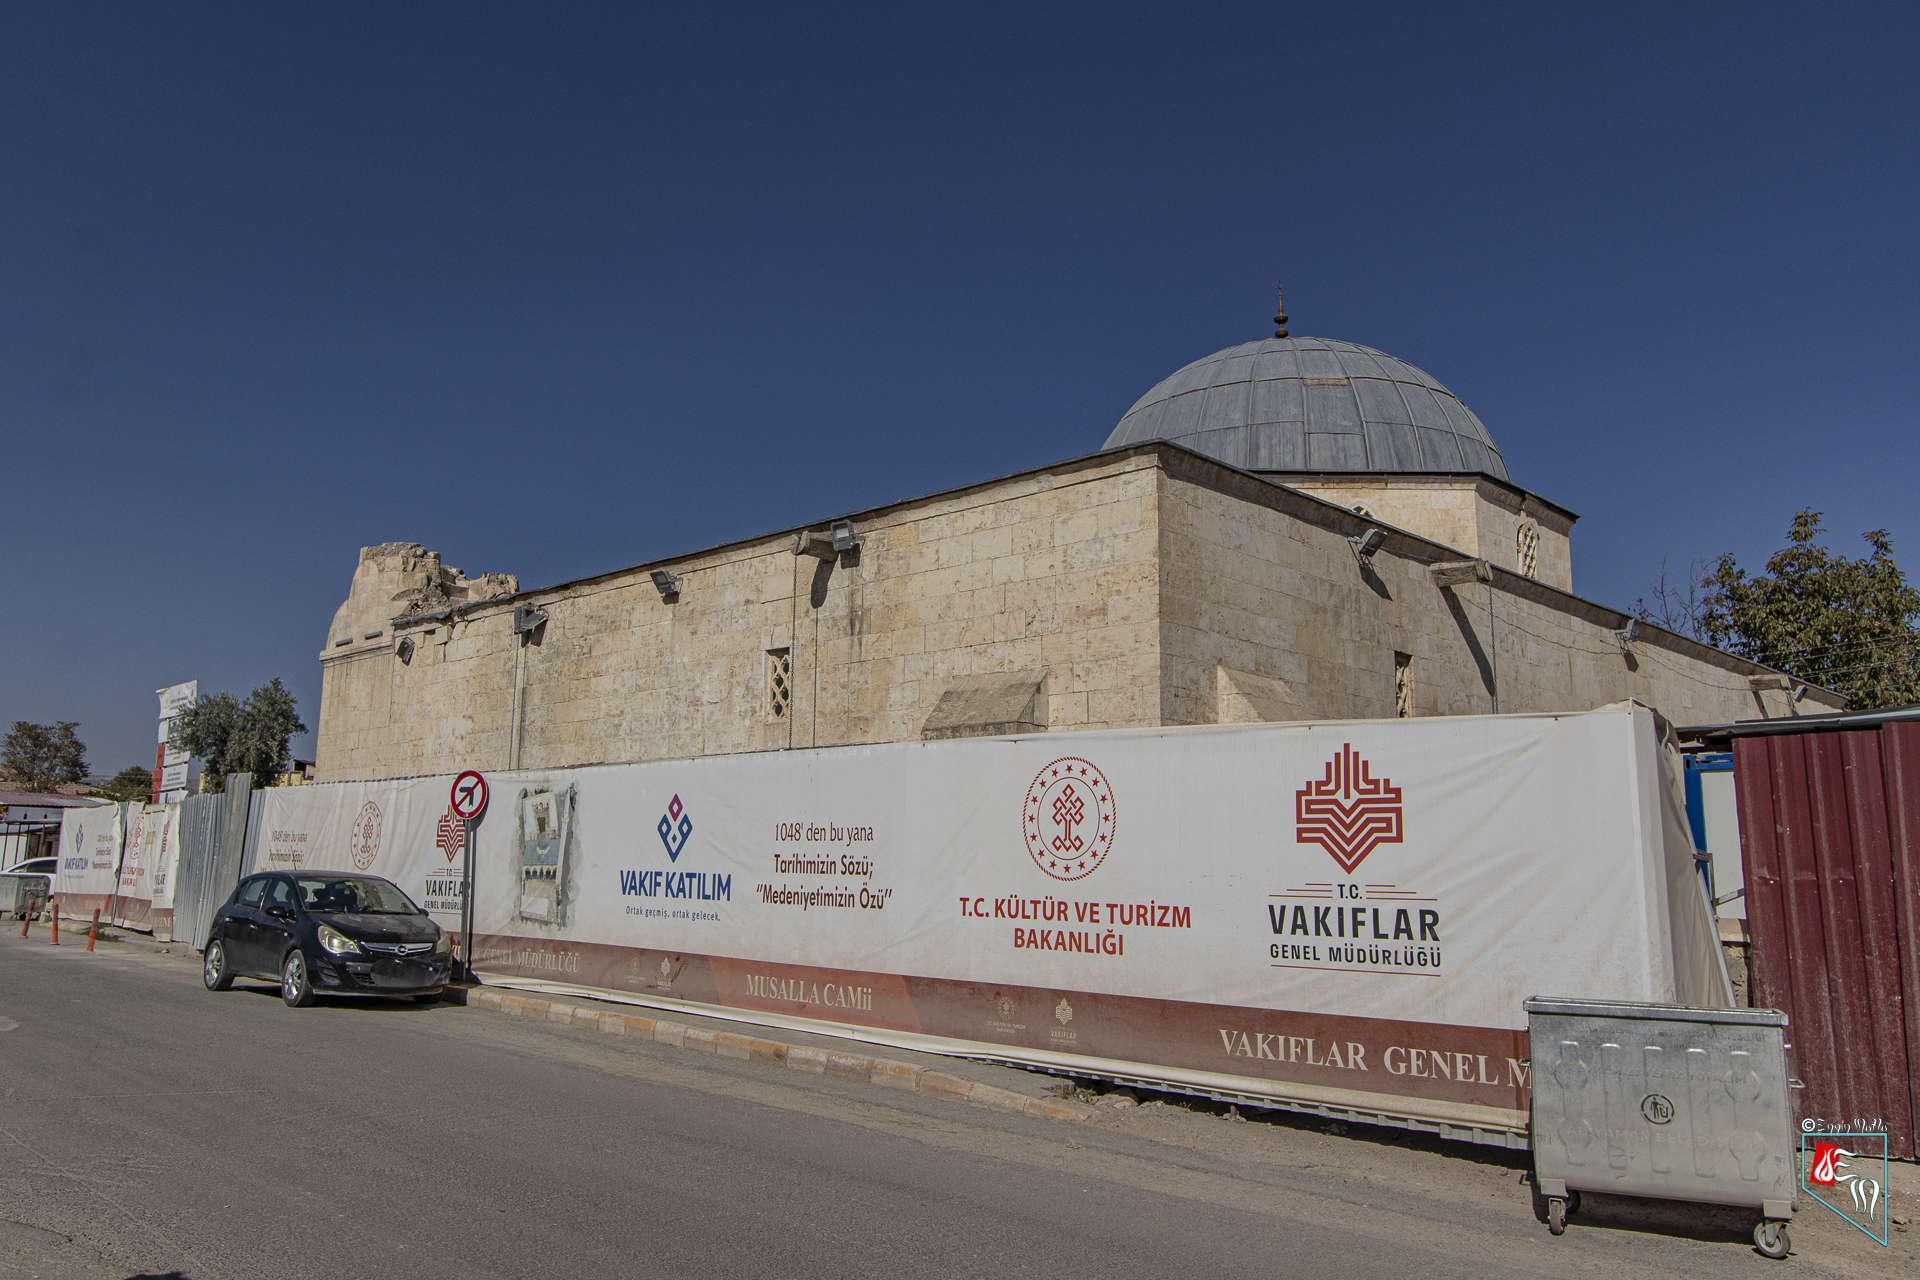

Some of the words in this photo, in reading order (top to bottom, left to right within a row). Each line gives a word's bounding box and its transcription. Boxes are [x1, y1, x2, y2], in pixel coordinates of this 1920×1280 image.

[774, 821, 804, 842] 1048'
[806, 822, 826, 843] den
[830, 821, 843, 843] bu
[847, 825, 874, 847] yana
[774, 852, 837, 876] Tarihimizin
[840, 855, 874, 880] Sözü;
[620, 869, 662, 898] VAKIF
[665, 871, 732, 902] KATILIM
[1337, 883, 1363, 900] T.C.
[424, 900, 439, 909] GENEL
[625, 904, 644, 917] Ortak
[645, 907, 670, 920] geçmiş,
[672, 909, 690, 922] ortak
[691, 910, 721, 923] gelecek.
[959, 896, 990, 919] T.C.
[994, 893, 1069, 923] KÜLTÜR
[1074, 900, 1100, 924] VE
[1106, 899, 1192, 929] TURİZM
[1267, 904, 1441, 942] VAKIFLAR
[1013, 927, 1124, 956] BAKANLIĞI
[1269, 943, 1321, 962] GENEL
[1328, 942, 1442, 968] MÜDÜRLÜĞÜ
[745, 973, 821, 1005] MUSALLA
[1050, 1030, 1077, 1040] VAKIFLAR
[1219, 1027, 1369, 1072] VAKIFLAR
[1383, 1045, 1499, 1087] GENEL
